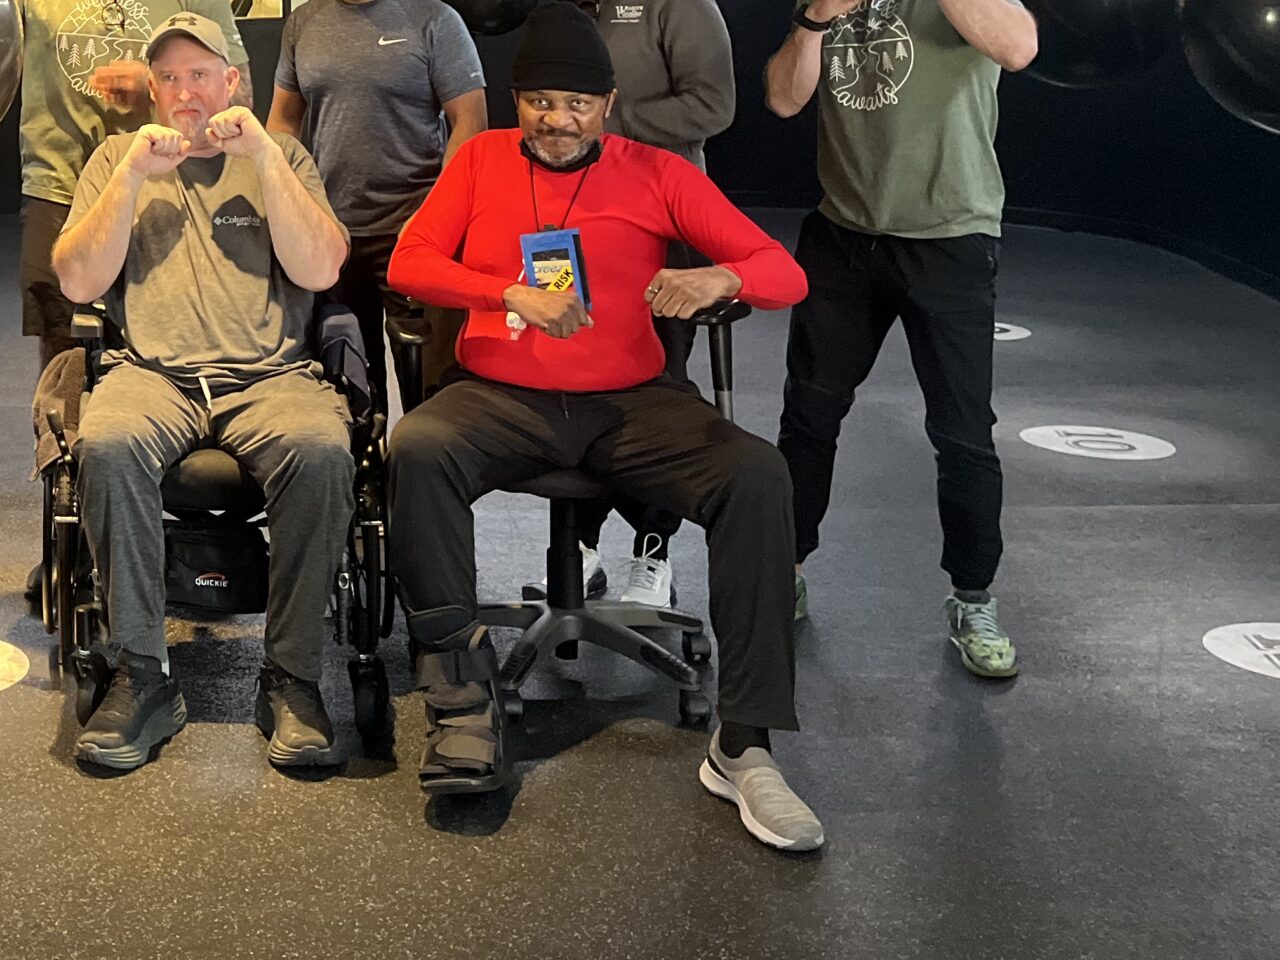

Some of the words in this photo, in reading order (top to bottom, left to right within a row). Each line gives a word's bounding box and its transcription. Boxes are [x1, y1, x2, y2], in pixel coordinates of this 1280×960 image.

[837, 82, 899, 111] awaits
[222, 214, 260, 225] Columbia
[553, 268, 574, 290] RISK
[1056, 429, 1137, 451] 10
[194, 577, 228, 588] QUICKIE
